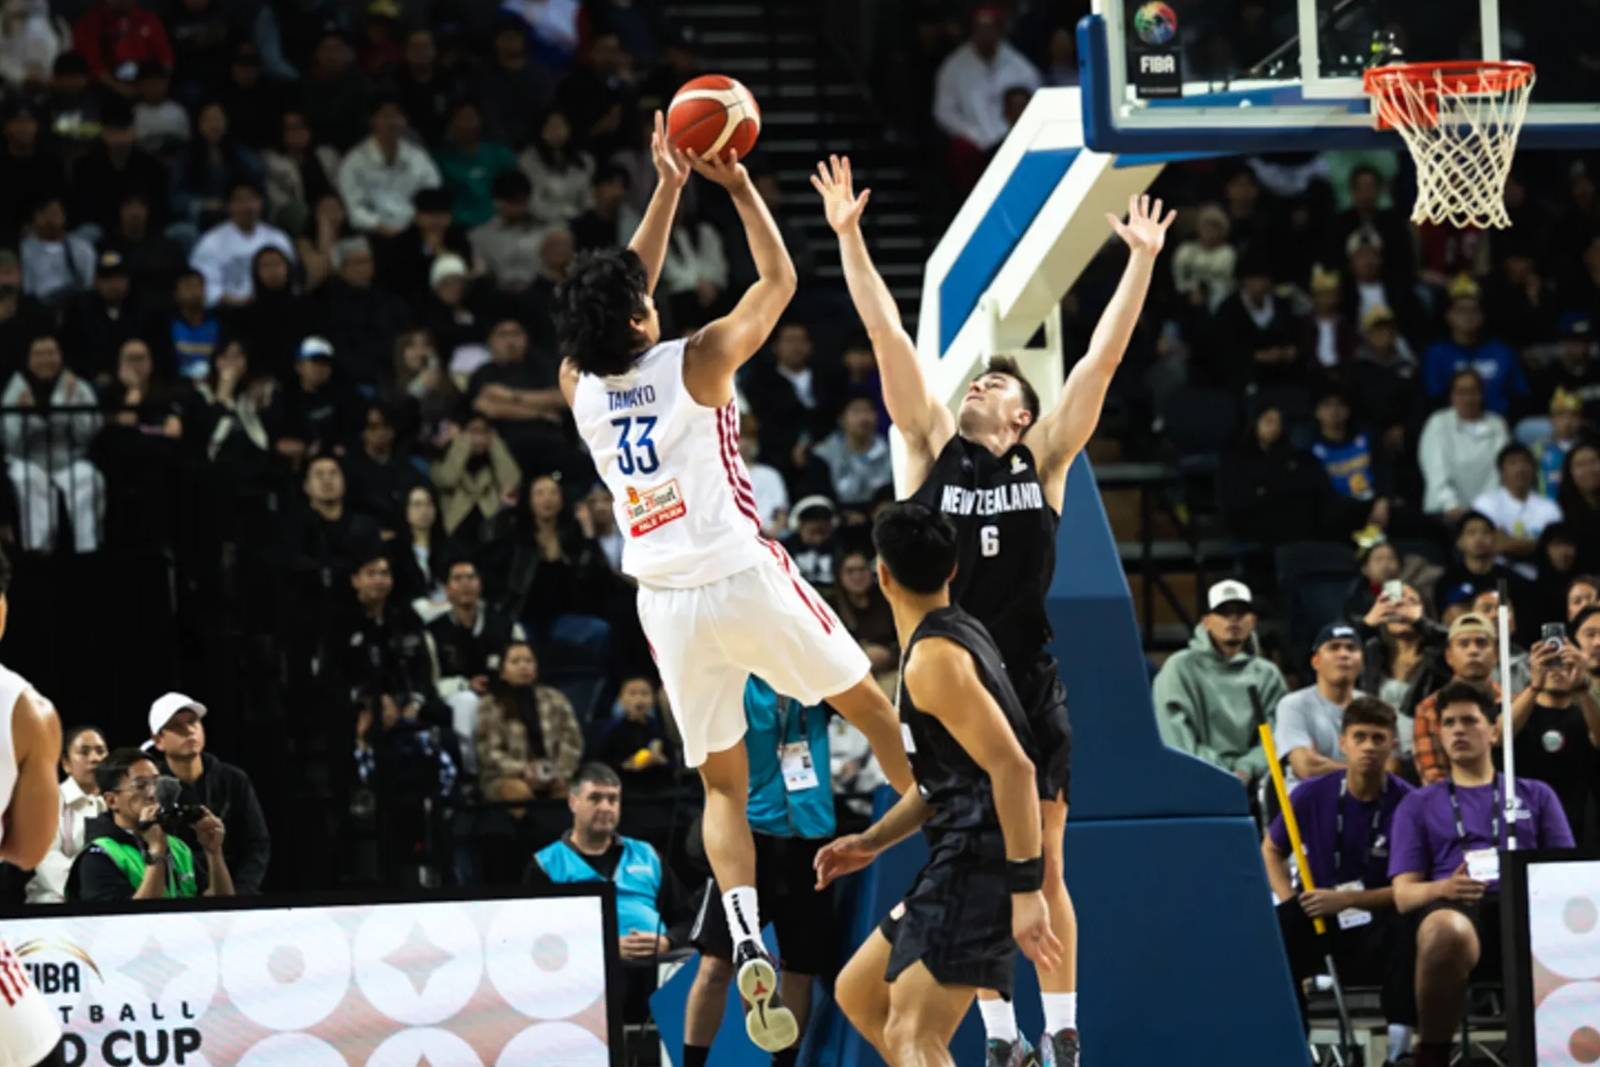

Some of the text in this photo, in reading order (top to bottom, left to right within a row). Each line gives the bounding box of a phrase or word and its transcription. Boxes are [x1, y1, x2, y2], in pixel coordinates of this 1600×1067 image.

[1140, 54, 1175, 73] FIBA
[607, 385, 656, 411] TAMAYO
[610, 416, 660, 475] 33
[940, 481, 1043, 516] NEW ZEALAND
[980, 525, 999, 557] 6
[24, 961, 80, 994] IBA
[101, 1027, 202, 1067] CUP
